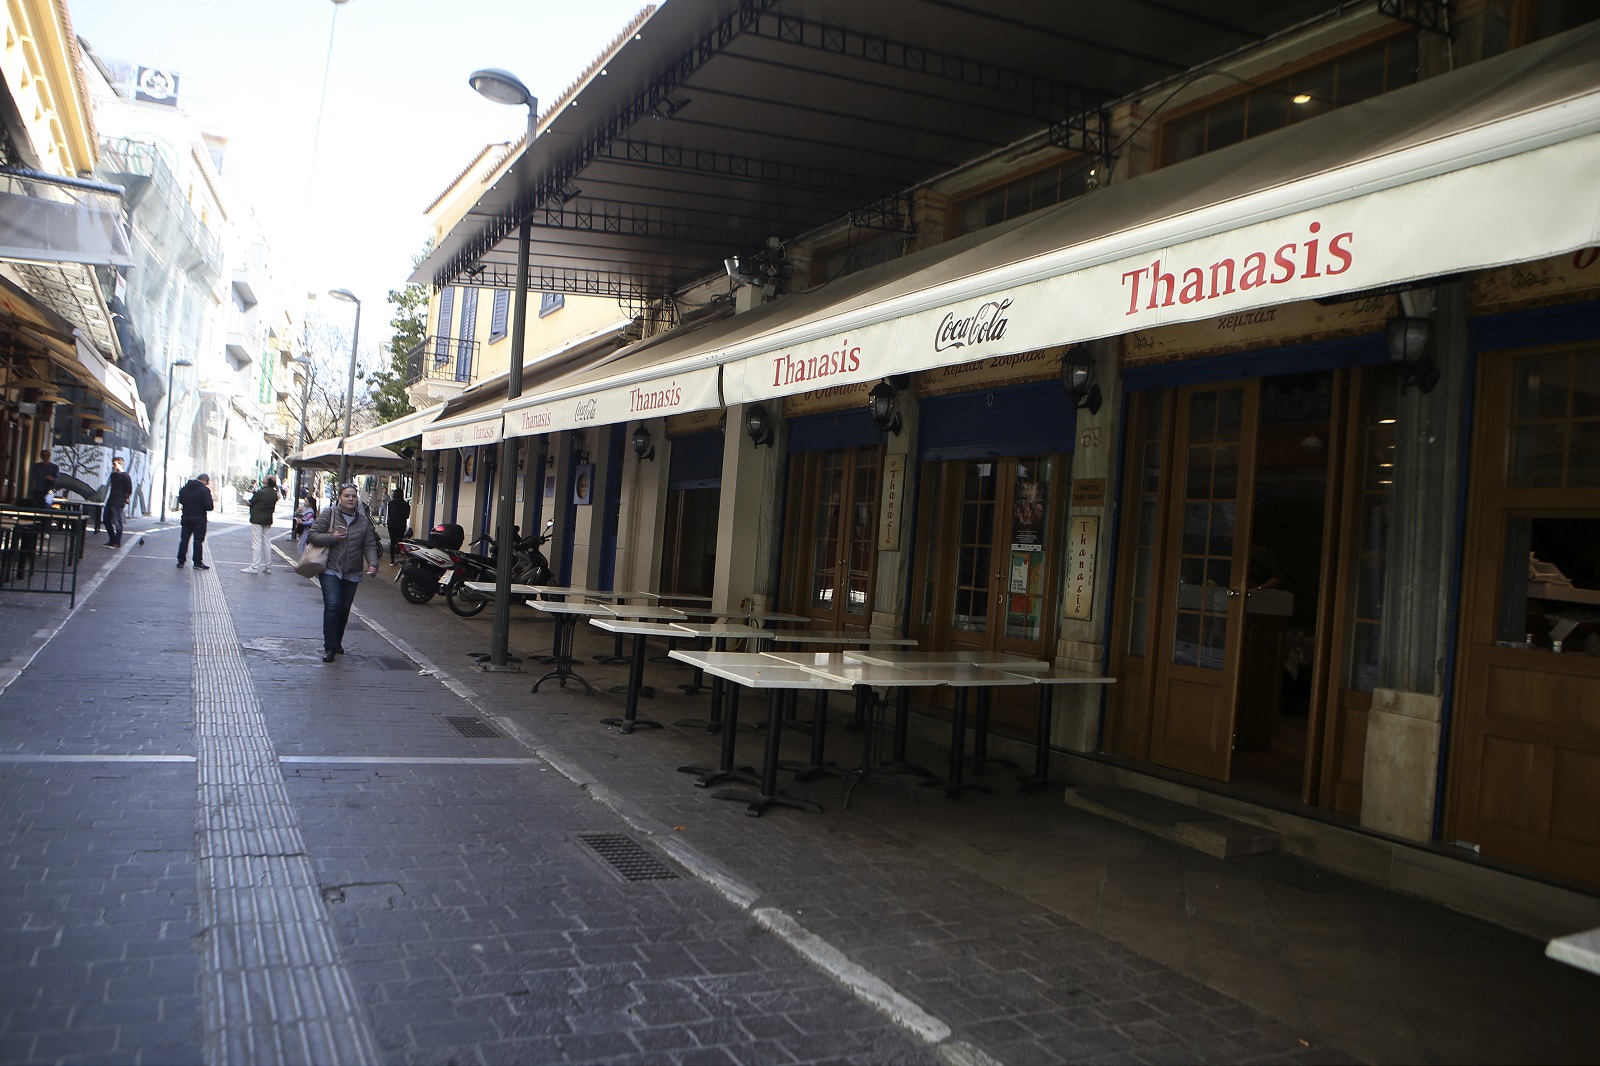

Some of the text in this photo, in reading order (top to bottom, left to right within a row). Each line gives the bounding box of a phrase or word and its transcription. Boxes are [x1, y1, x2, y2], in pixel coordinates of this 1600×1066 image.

[772, 338, 861, 387] Thanasis
[1121, 221, 1354, 316] Thanasis
[521, 407, 551, 430] Thanasis
[629, 381, 682, 412] Thanasis
[1081, 426, 1103, 448] 69
[885, 469, 899, 544] Thanasis
[1074, 521, 1089, 613] Thanasis
